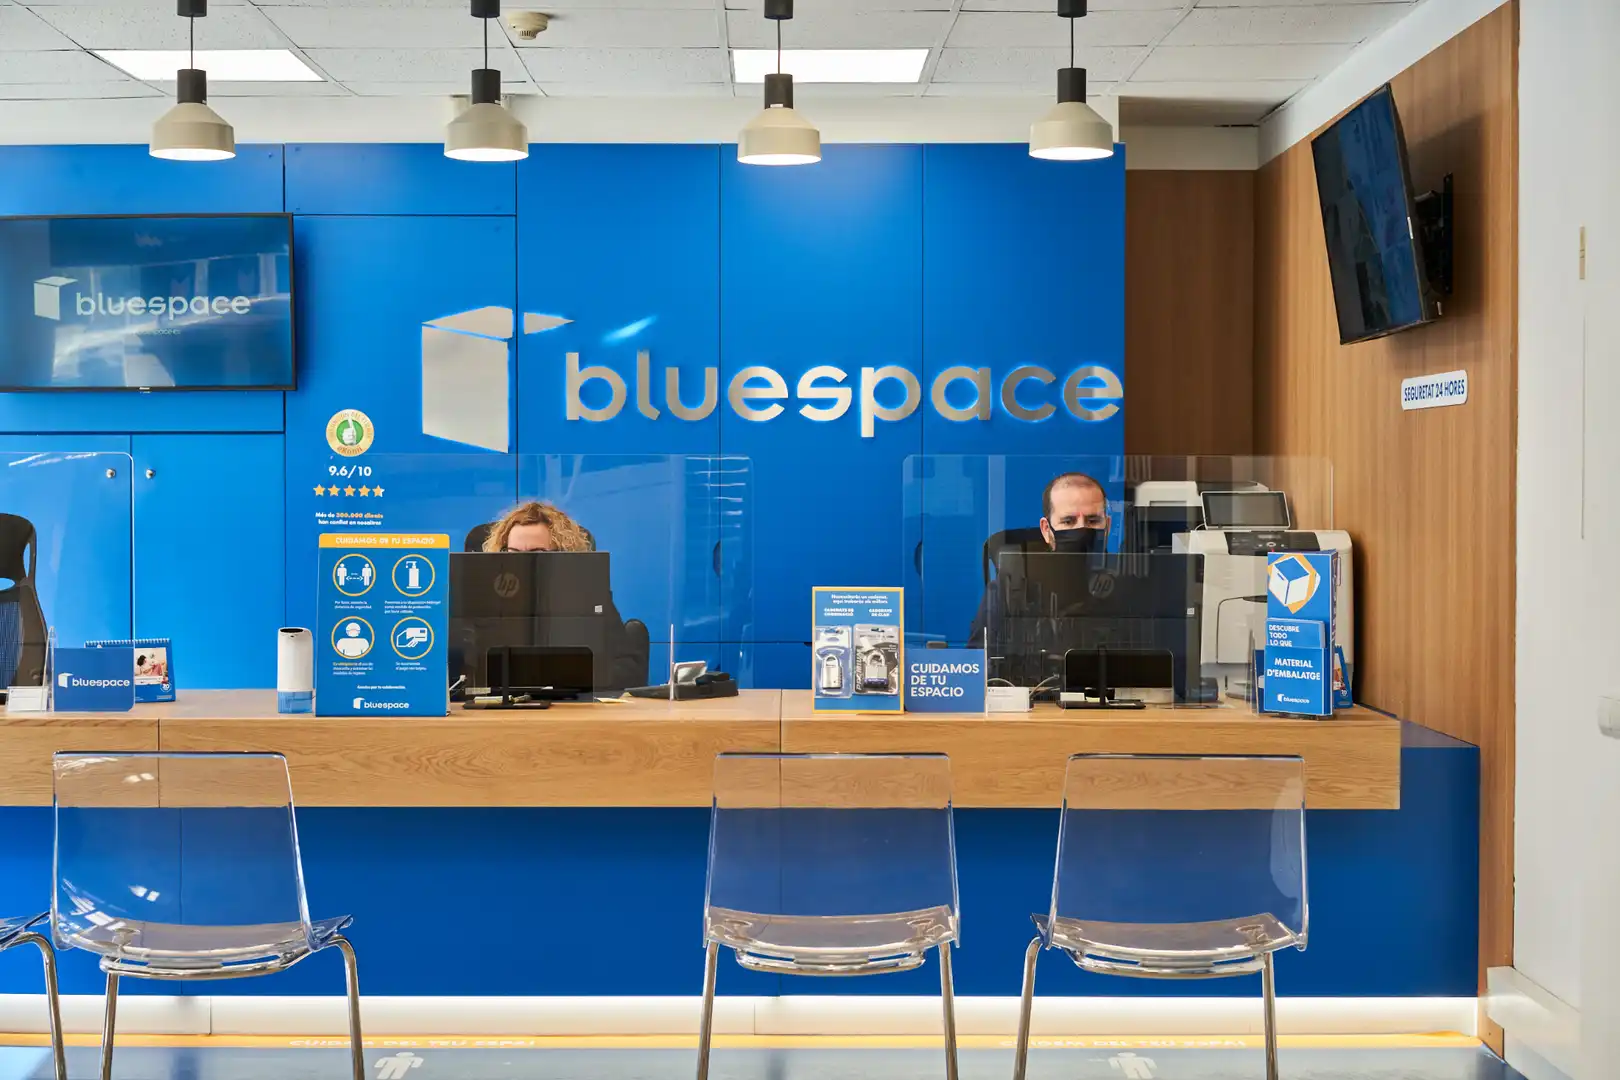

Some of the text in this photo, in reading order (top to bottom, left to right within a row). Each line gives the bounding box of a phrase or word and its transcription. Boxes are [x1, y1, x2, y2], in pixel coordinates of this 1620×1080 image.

[76, 292, 250, 321] bluespace
[565, 347, 1124, 438] bluespace
[1404, 379, 1465, 402] SEGURETAT 24 HORES
[328, 465, 373, 479] 9.6/10
[335, 537, 377, 545] CUIDAMOS
[391, 537, 401, 545] TU
[402, 537, 435, 545] ESPACIO
[1268, 624, 1300, 633] DESCUBRE
[1280, 640, 1293, 648] QUE
[910, 663, 980, 674] CUIDAMOS
[1274, 657, 1314, 669] MATERIAL
[1266, 668, 1321, 681] D'EMBALATGE
[72, 677, 131, 688] bluespace
[910, 675, 947, 686] DE TU
[910, 686, 964, 697] ESPACIO
[363, 701, 410, 710] bluespace
